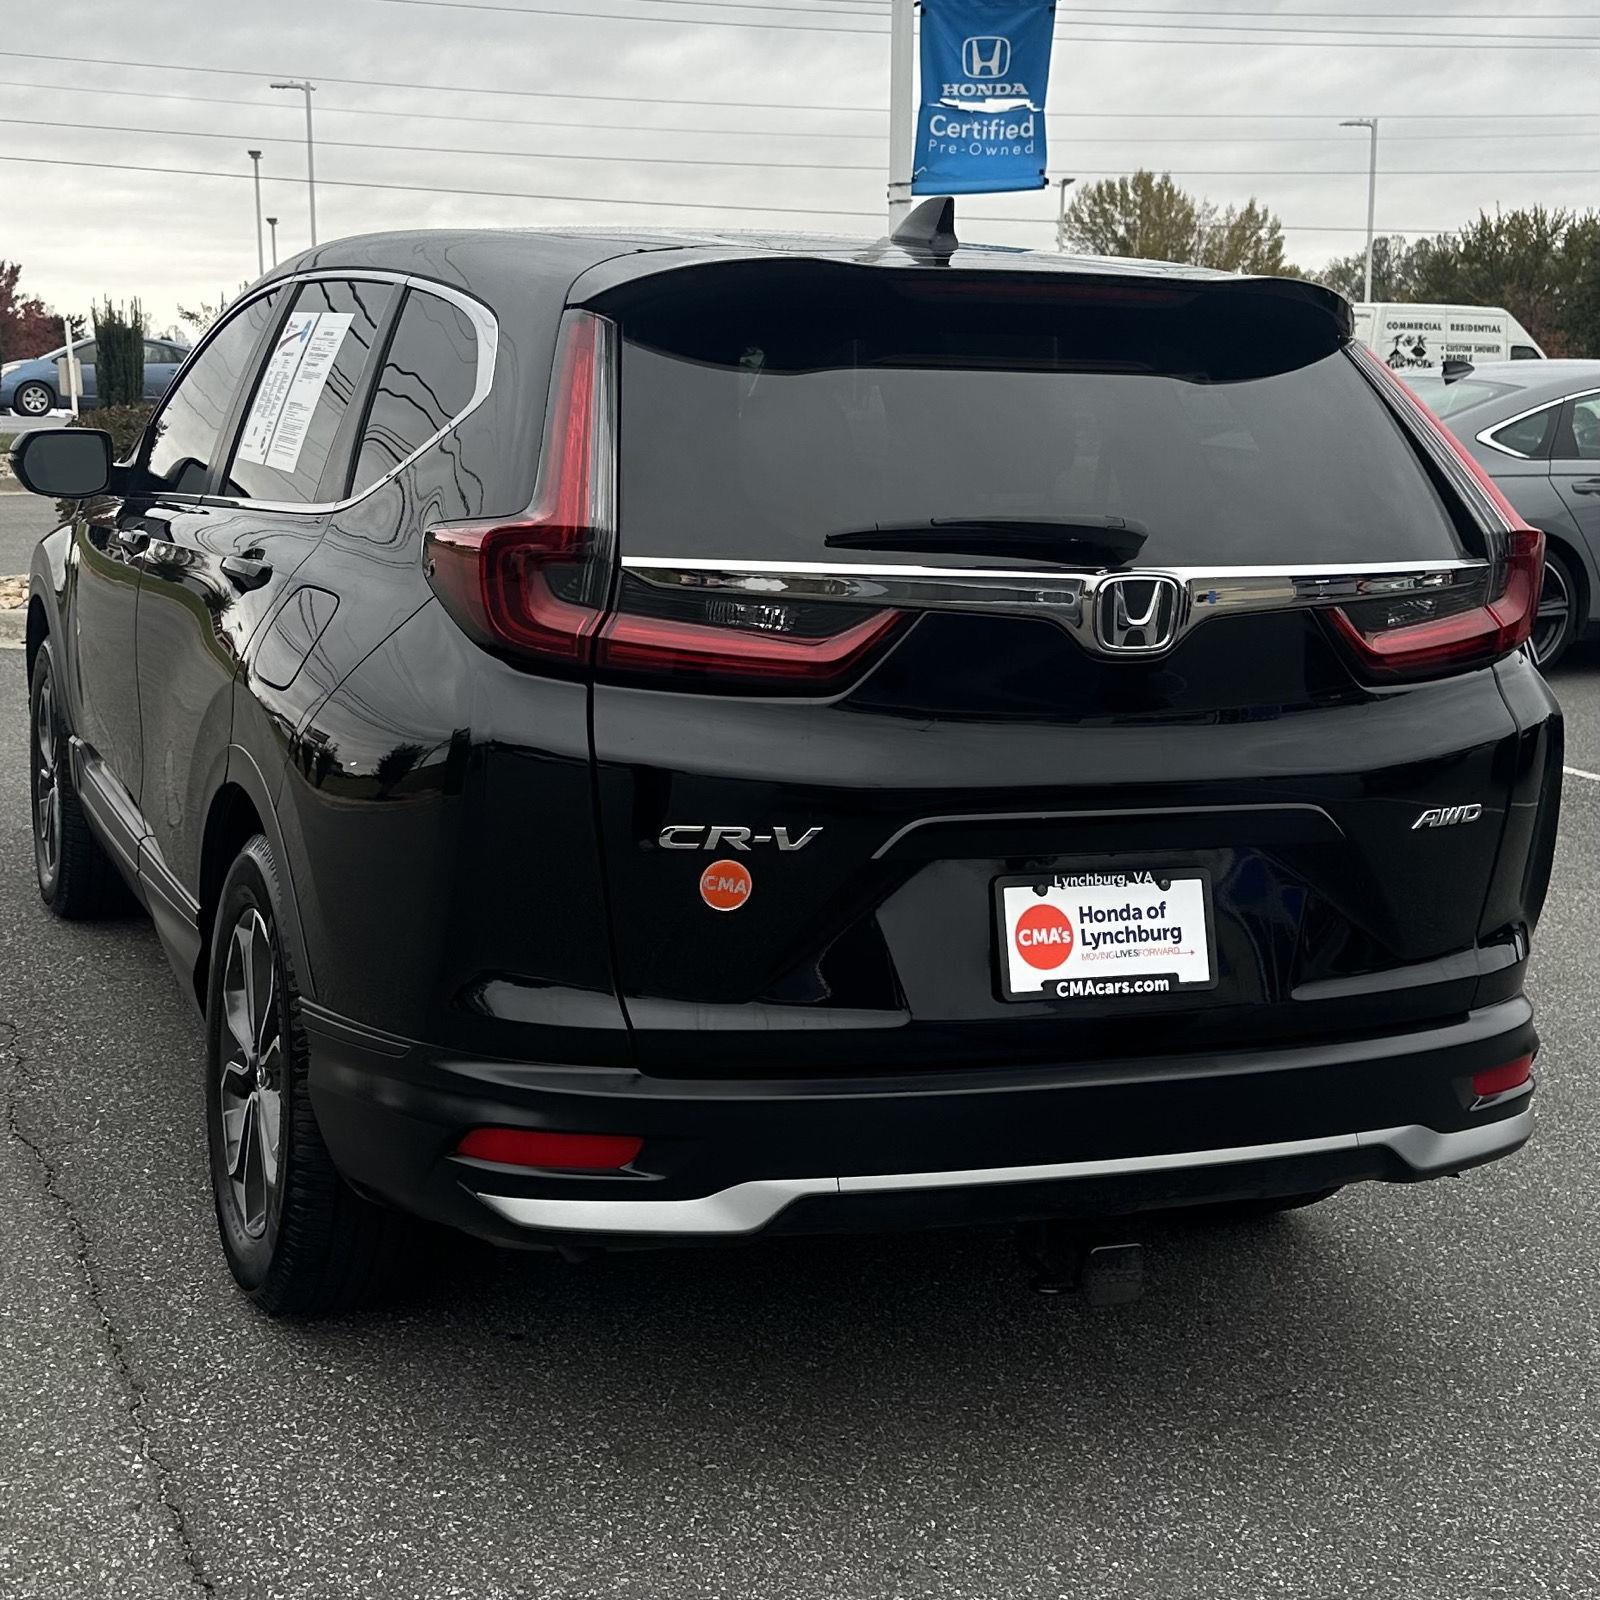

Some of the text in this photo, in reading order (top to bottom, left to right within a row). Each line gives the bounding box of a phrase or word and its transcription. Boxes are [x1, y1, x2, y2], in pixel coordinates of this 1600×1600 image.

[942, 83, 1029, 96] HONDA
[929, 115, 1034, 140] Certified
[928, 139, 1034, 156] Pre-Owned
[1386, 321, 1501, 333] COMMERCIAL RESIDENTIAL
[1445, 344, 1501, 353] CUSTOM SHOWER
[1411, 803, 1482, 829] AWD
[658, 825, 824, 851] CR-V
[704, 875, 747, 894] CMA
[1054, 871, 1154, 889] Lynchburg, VA
[1078, 901, 1167, 924] Honda of
[1018, 927, 1072, 948] CMA's
[1080, 925, 1182, 950] Lynchburg
[1056, 978, 1170, 998] CMAcars.com
